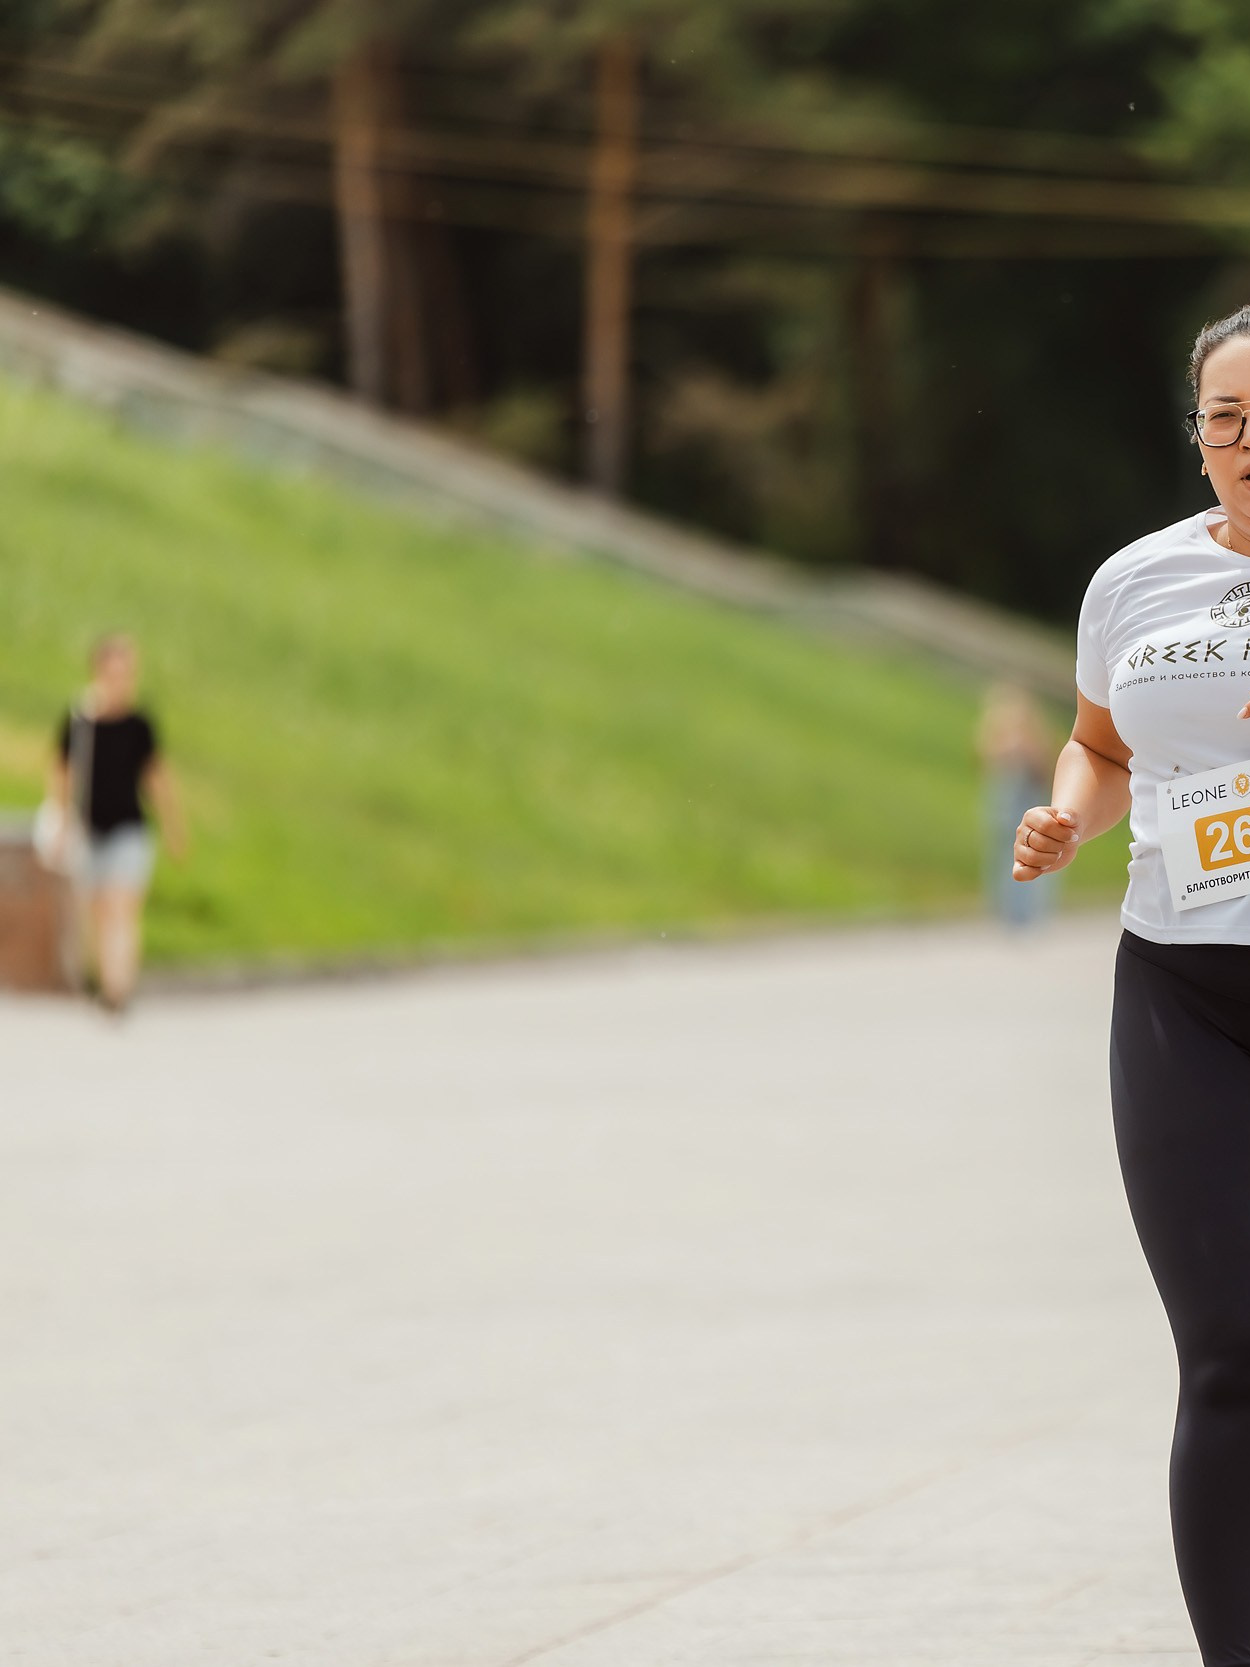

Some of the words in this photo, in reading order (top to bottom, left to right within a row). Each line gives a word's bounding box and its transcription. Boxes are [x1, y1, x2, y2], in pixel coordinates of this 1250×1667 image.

[1127, 639, 1227, 670] GREEK
[1171, 671, 1226, 681] качество
[1171, 783, 1228, 811] LEONE
